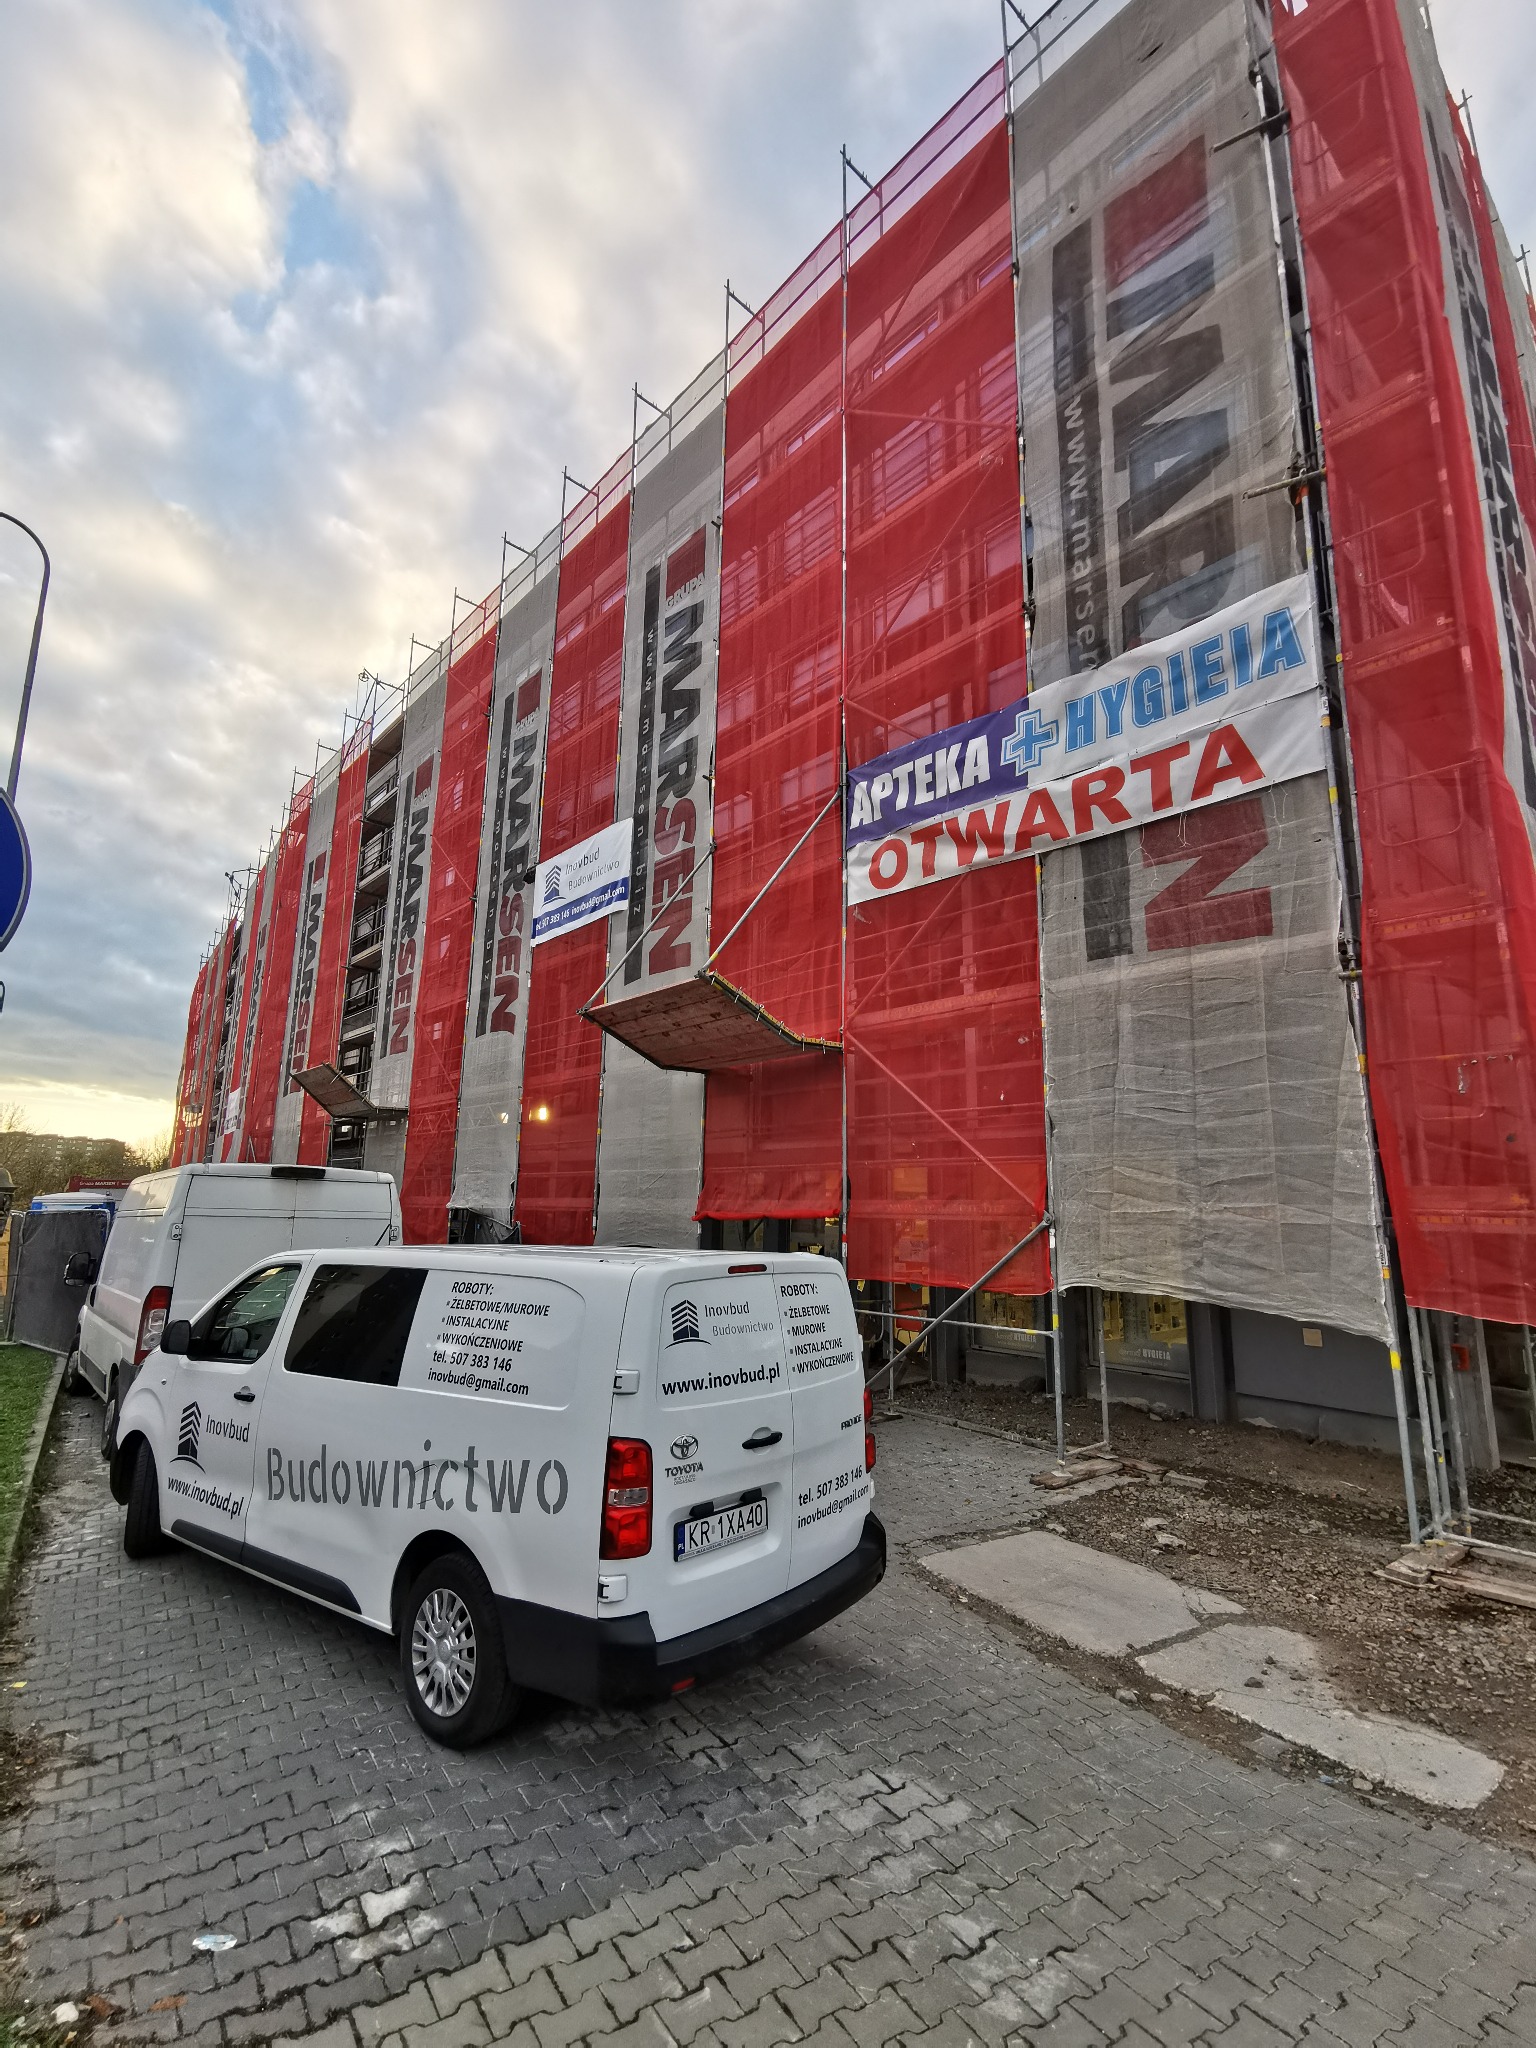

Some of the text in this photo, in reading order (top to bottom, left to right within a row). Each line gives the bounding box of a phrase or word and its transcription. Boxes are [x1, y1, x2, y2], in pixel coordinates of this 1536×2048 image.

[666, 571, 705, 611] GRUPA
[849, 607, 1306, 830] APTEKA HYGIEIA
[633, 628, 656, 914] www.marsen.biz
[648, 600, 705, 976] MARSEN
[868, 723, 1266, 890] OTWARTA
[565, 847, 600, 875] Inovbud
[568, 860, 620, 890] Budownictwo
[490, 729, 539, 1035] MARSEN
[389, 805, 430, 1056] MARSEN
[451, 1281, 495, 1295] ROBOTY:
[780, 1283, 819, 1298] ROBOTY:
[450, 1296, 550, 1316] ŻELBETOWE/MUROWE
[705, 1301, 750, 1318] Inovbud
[789, 1304, 830, 1319] ŻELBETOWE
[446, 1315, 510, 1331] INSTALACYJNE
[712, 1321, 774, 1336] Budownictwo
[791, 1322, 826, 1336] MUROWE
[442, 1332, 523, 1352] WYKOŃCZENIOWE
[794, 1337, 843, 1356] INSTALACYJNE
[433, 1350, 512, 1372] tel. 507 383 146
[797, 1351, 854, 1374] WYKOŃCZENIOWE
[428, 1367, 529, 1395] inovbud@gmail.com
[661, 1362, 780, 1395] www.inovbud.pl
[206, 1414, 250, 1442] Inovbud
[267, 1439, 568, 1515] Budownictwo
[665, 1461, 703, 1478] TOYOTA
[168, 1477, 244, 1519] www.inovbud.pl
[798, 1465, 863, 1507] tel. 507 383 146
[798, 1484, 869, 1529] inovbud@gmail.com
[689, 1521, 710, 1549] KR
[718, 1504, 762, 1539] 1XA40
[678, 1543, 685, 1551] PL
